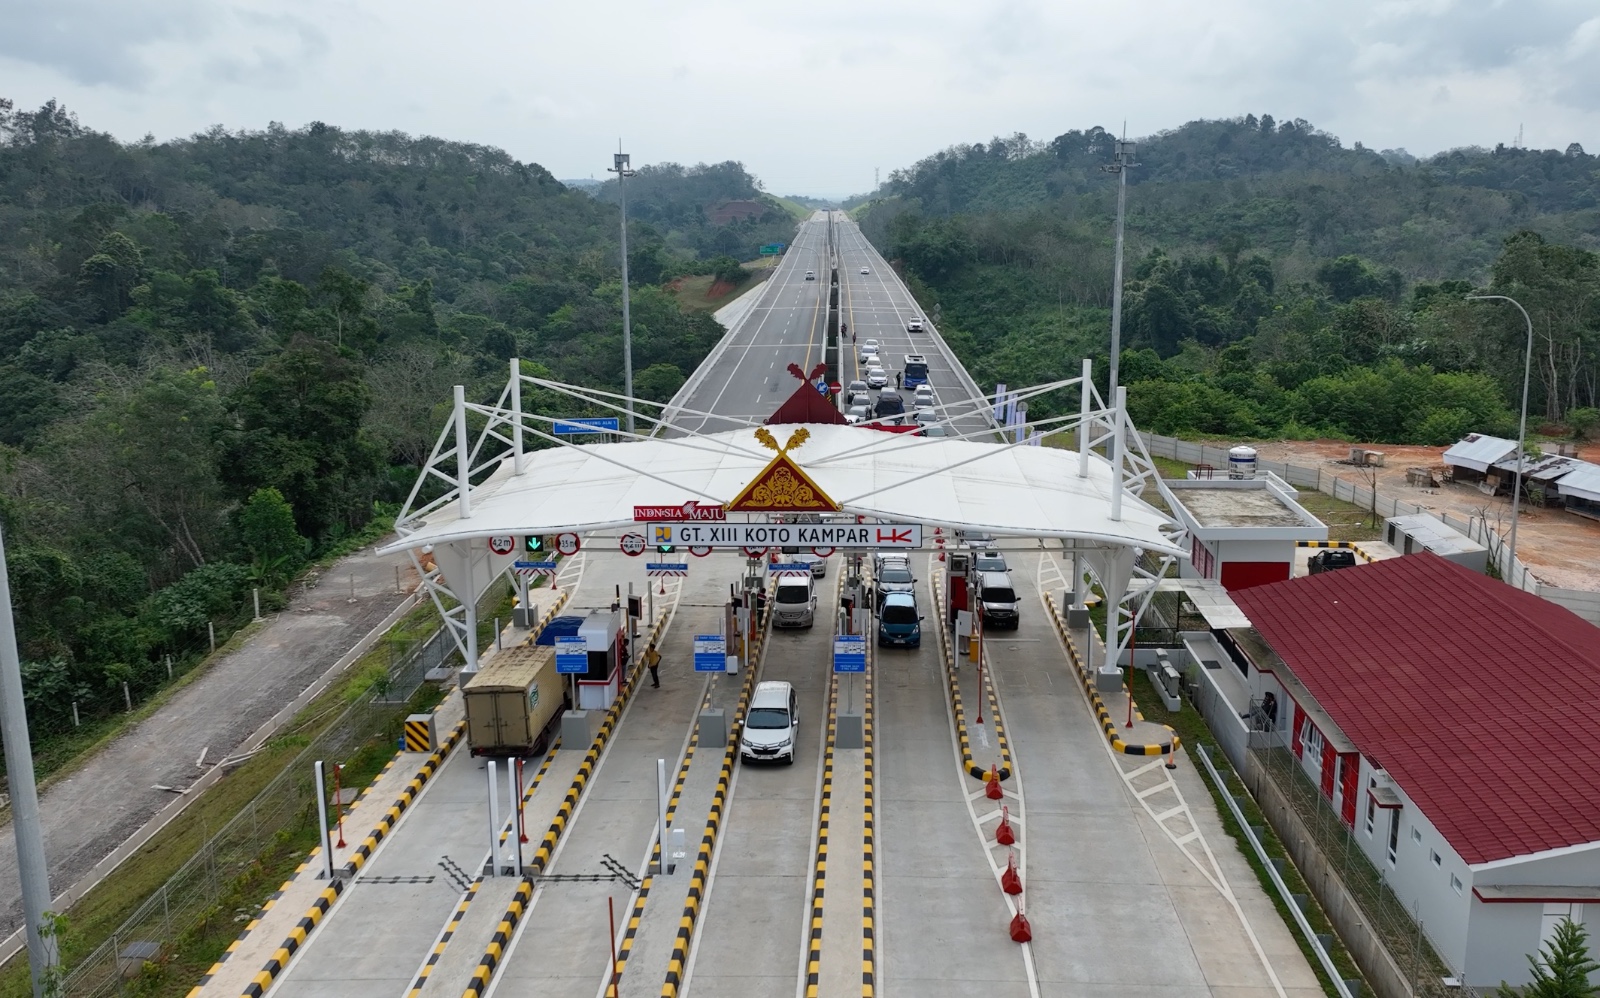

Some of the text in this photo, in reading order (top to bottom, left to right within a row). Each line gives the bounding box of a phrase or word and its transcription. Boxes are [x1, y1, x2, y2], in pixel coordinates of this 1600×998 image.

[689, 508, 726, 520] MAJU
[680, 527, 705, 542] GT.
[710, 527, 738, 542] XIII
[745, 527, 790, 543] KOTO
[799, 528, 869, 543] KAMPAR
[492, 539, 503, 548] 4,2
